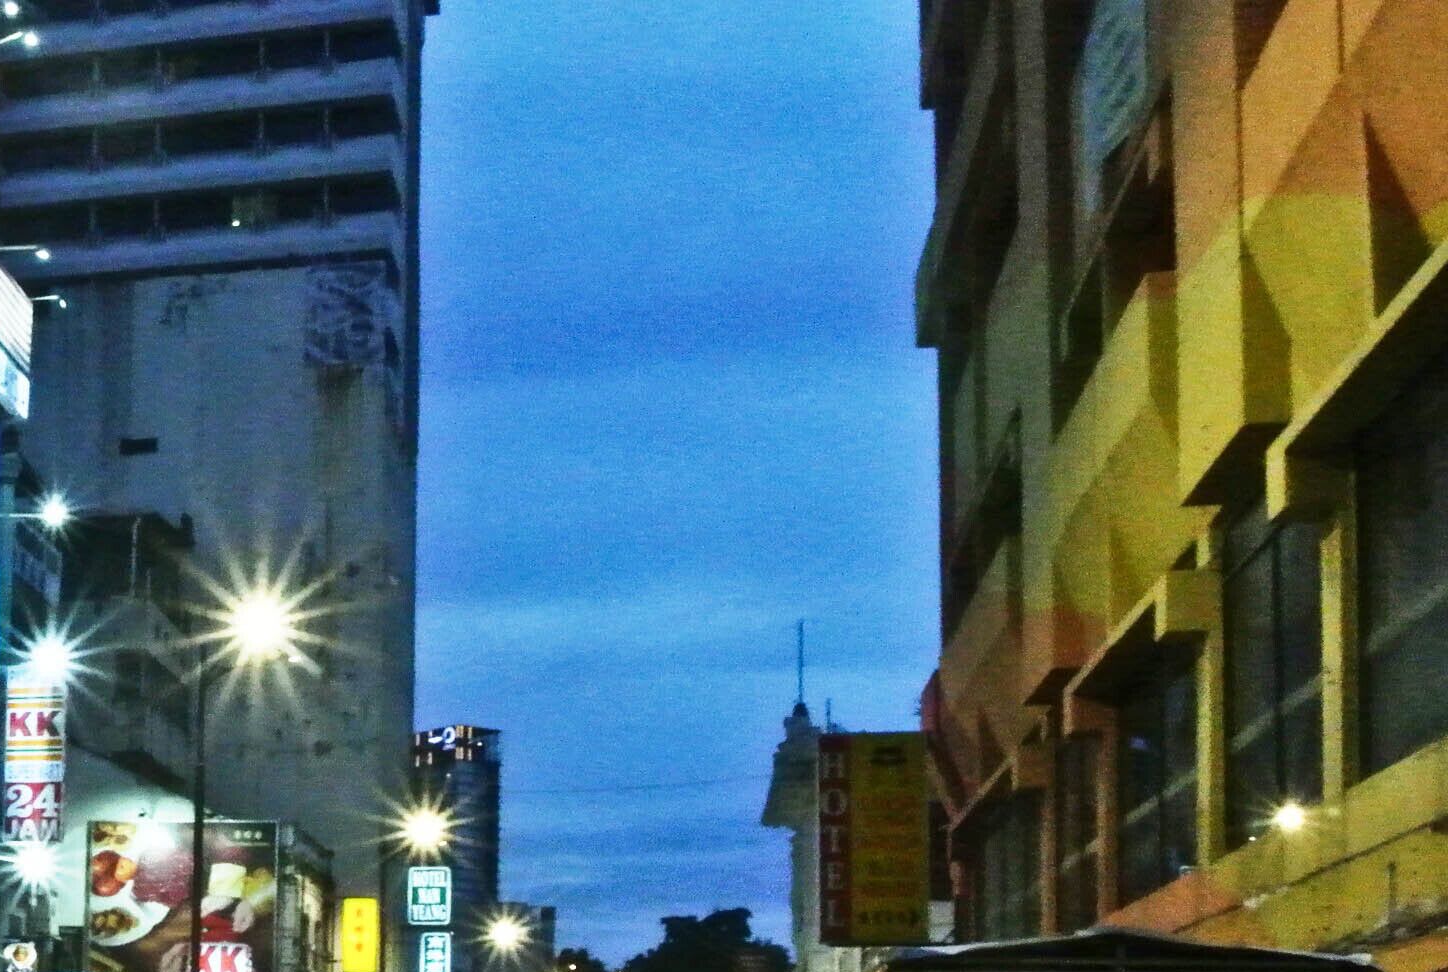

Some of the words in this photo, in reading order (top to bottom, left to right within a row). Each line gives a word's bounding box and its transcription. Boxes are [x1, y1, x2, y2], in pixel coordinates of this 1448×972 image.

[9, 711, 61, 737] KK
[6, 783, 60, 819] 24
[821, 750, 849, 928] HOTEL
